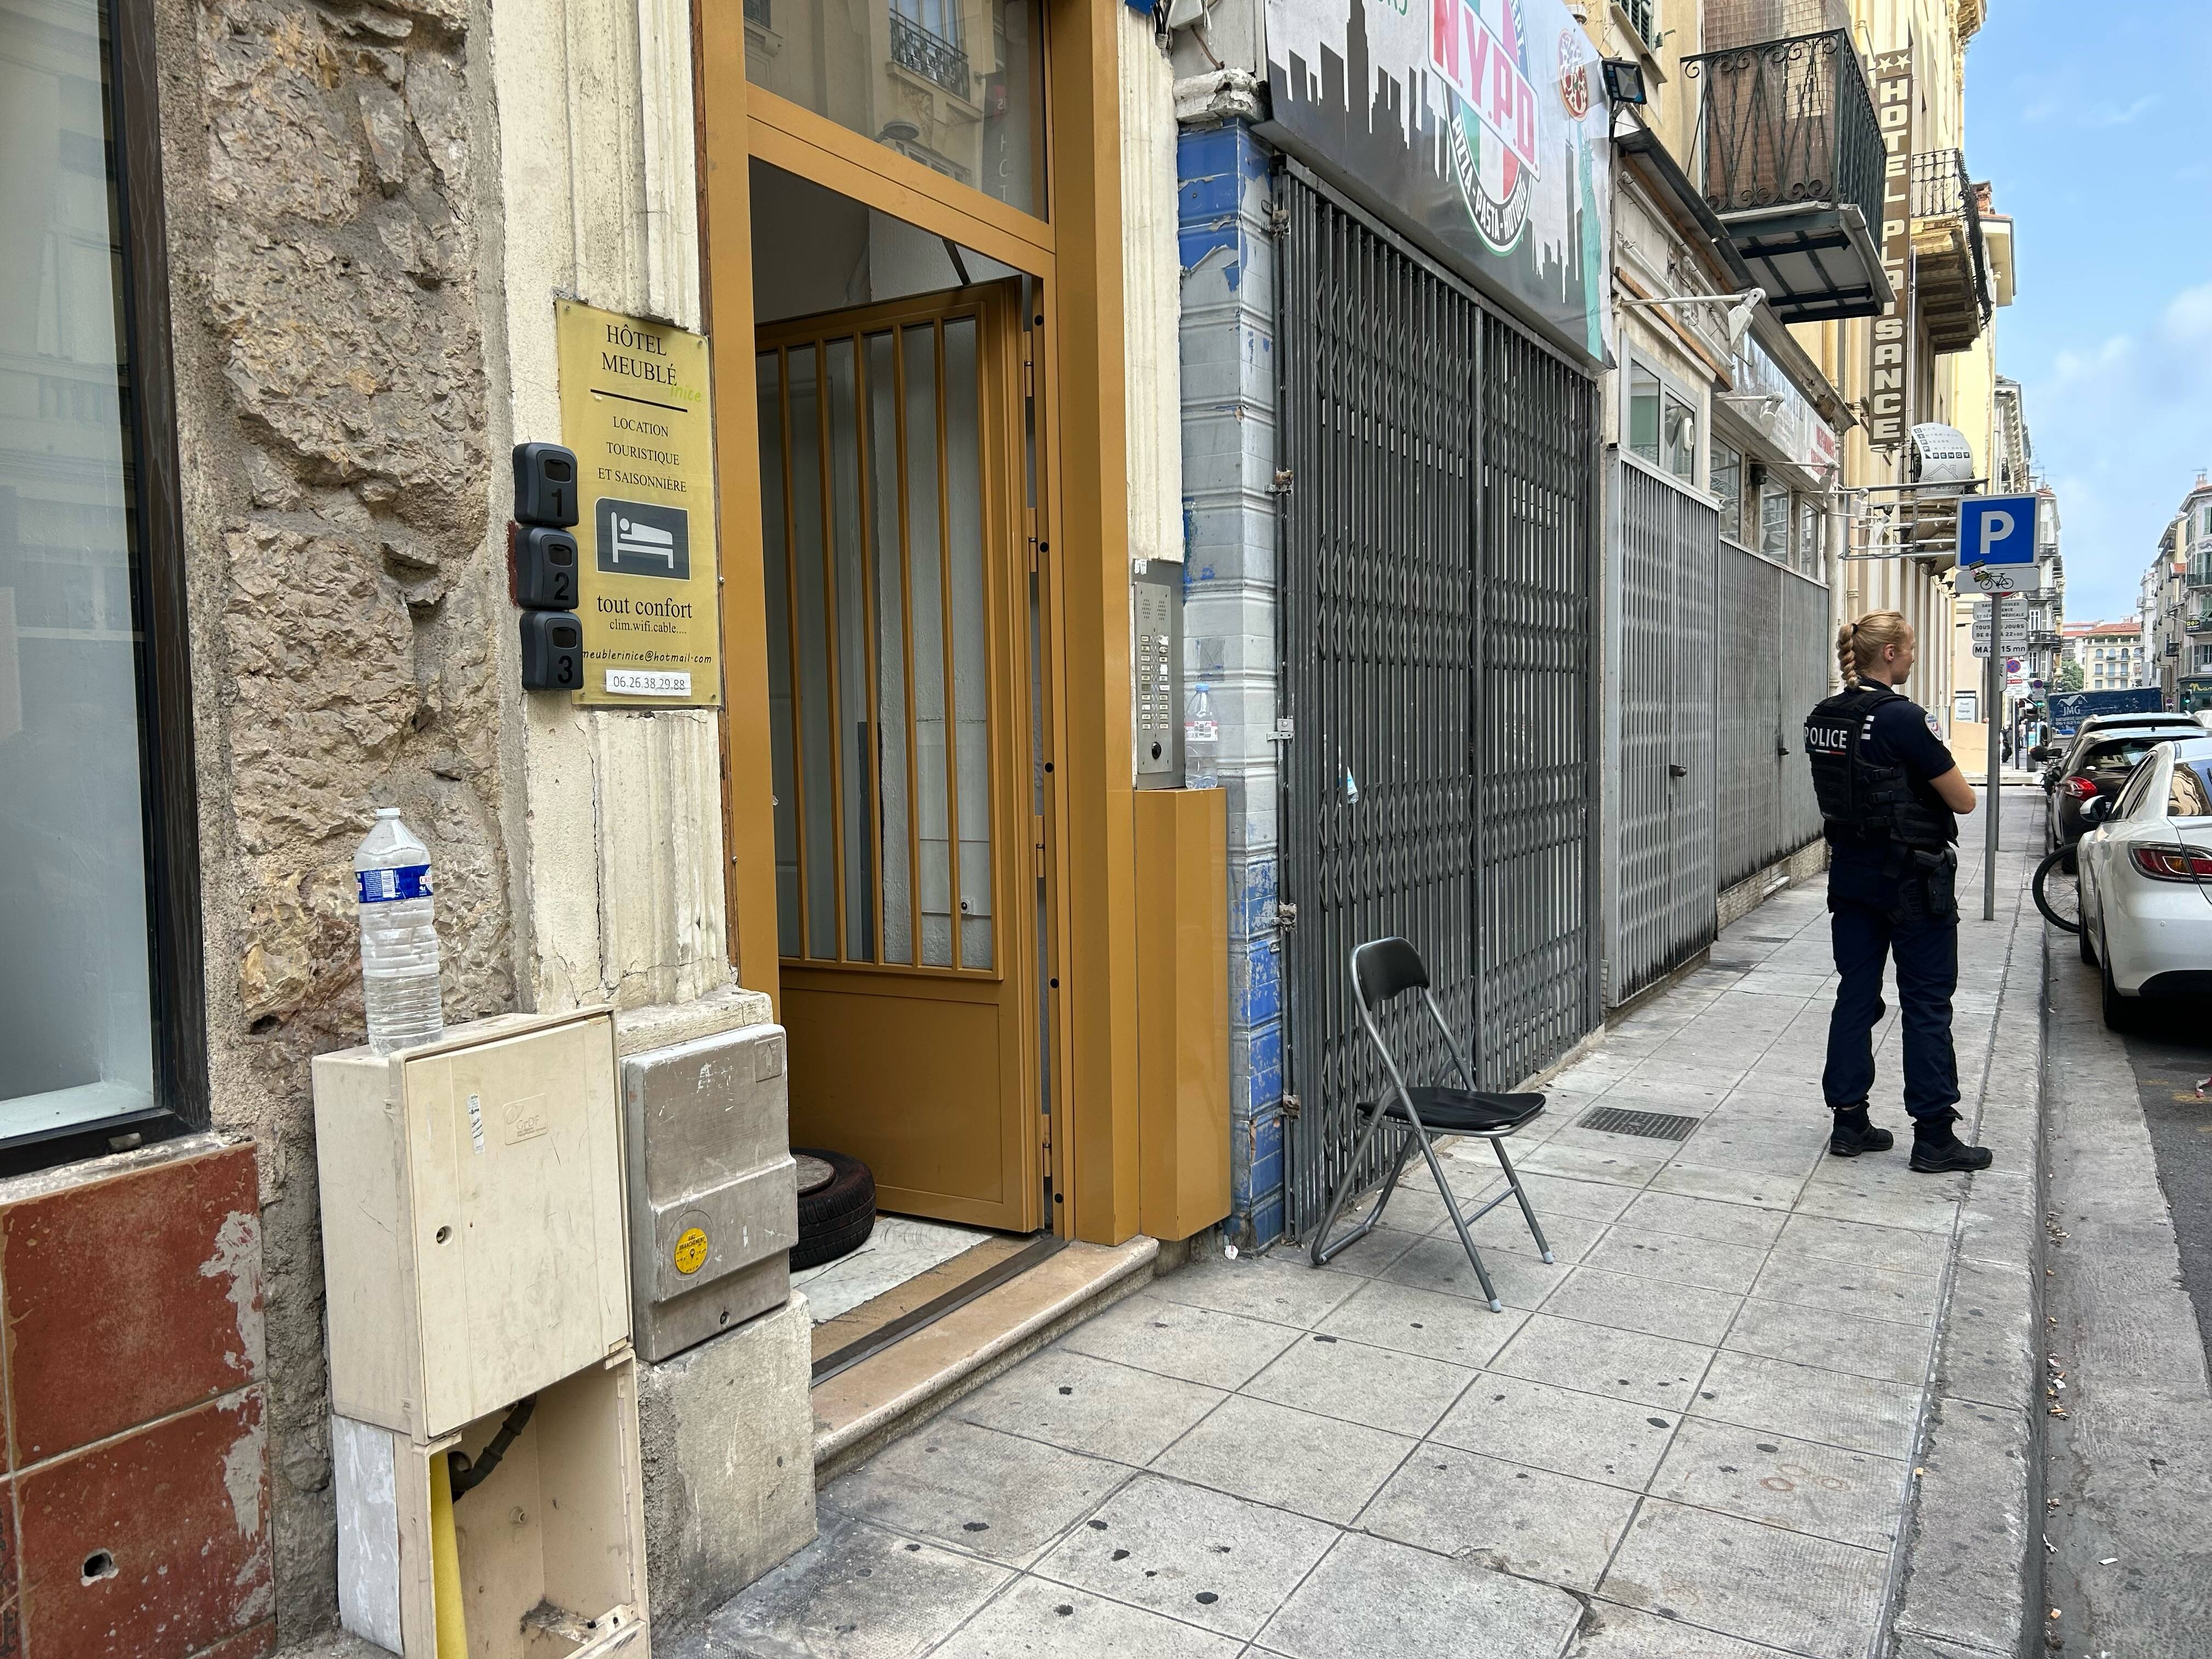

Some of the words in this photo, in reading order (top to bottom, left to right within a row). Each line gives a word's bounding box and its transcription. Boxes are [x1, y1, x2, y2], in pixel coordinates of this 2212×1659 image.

[1880, 78, 1908, 203] HOTEL
[606, 324, 667, 356] HÔTEL
[601, 352, 678, 386] MEUBLÉ
[613, 416, 669, 437] LOCATION
[606, 442, 680, 466] TOURISTIQUE
[598, 467, 612, 481] ET
[615, 471, 687, 493] SAISONNIÈRE
[551, 488, 562, 517] 1
[1980, 511, 2015, 554] P
[554, 572, 569, 601] 2
[597, 595, 630, 614] tout
[635, 597, 693, 618] confort
[557, 655, 573, 685] 3
[613, 675, 686, 690] 06.26.38.29.88
[2063, 706, 2081, 716] JMG
[1804, 726, 1848, 749] POLICE
